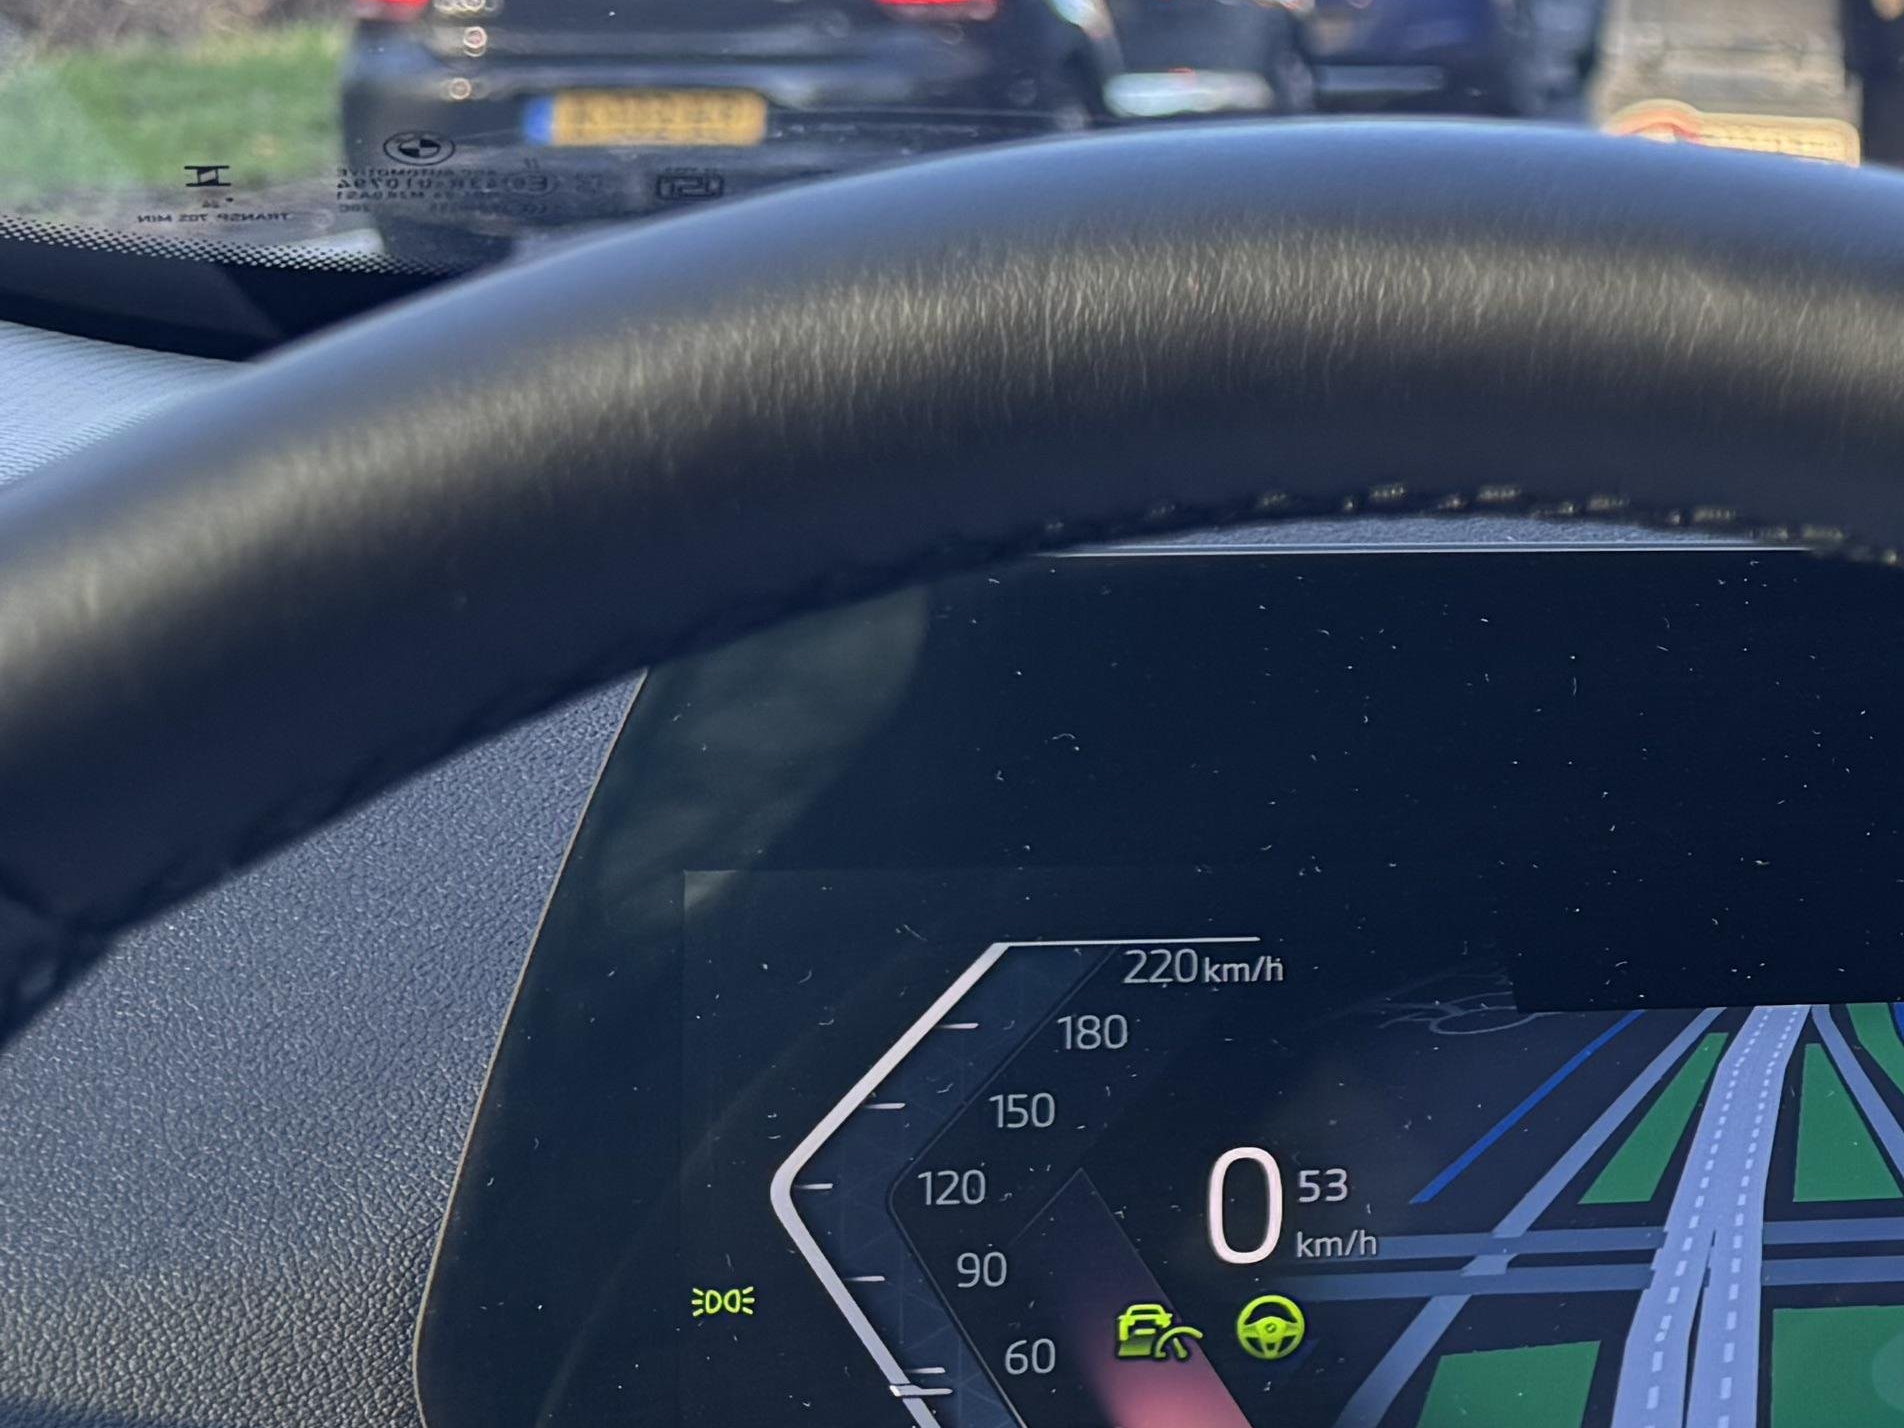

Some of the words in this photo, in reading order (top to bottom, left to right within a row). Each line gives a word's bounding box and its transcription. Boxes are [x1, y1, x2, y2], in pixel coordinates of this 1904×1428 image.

[1124, 948, 1199, 984] 220
[1204, 956, 1284, 984] km/h
[1058, 1016, 1129, 1049] 180
[989, 1094, 1056, 1128] 150
[918, 1170, 986, 1204] 120
[1208, 1147, 1283, 1263] 0
[1298, 1168, 1348, 1201] 53
[1296, 1231, 1378, 1259] km/h
[957, 1253, 1008, 1288] 90
[1004, 1340, 1056, 1374] 60
